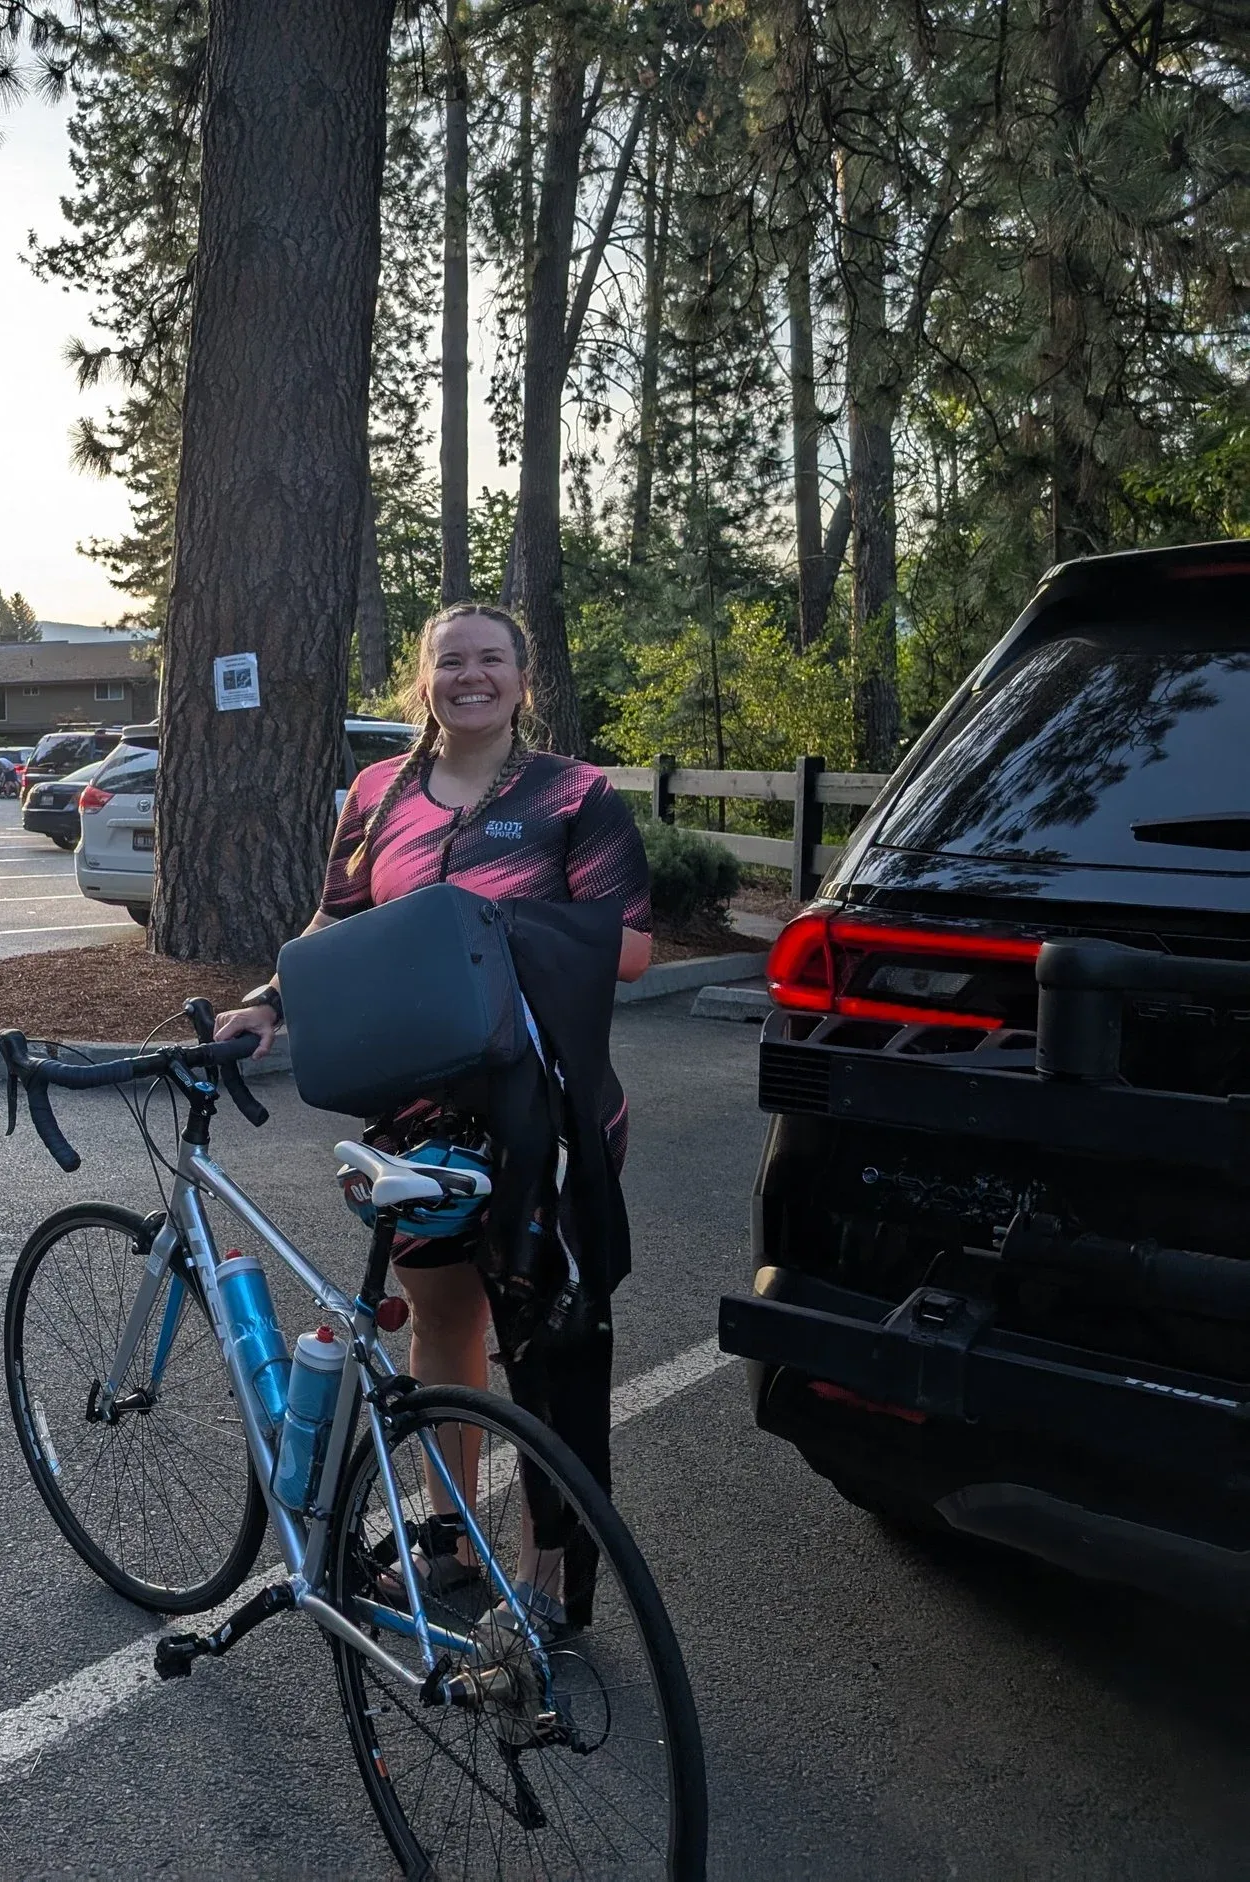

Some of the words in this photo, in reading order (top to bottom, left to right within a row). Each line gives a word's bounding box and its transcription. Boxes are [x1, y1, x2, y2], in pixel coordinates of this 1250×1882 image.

[486, 820, 522, 832] ZOOT
[489, 831, 522, 840] SPORTS
[1125, 1378, 1240, 1407] THULE
